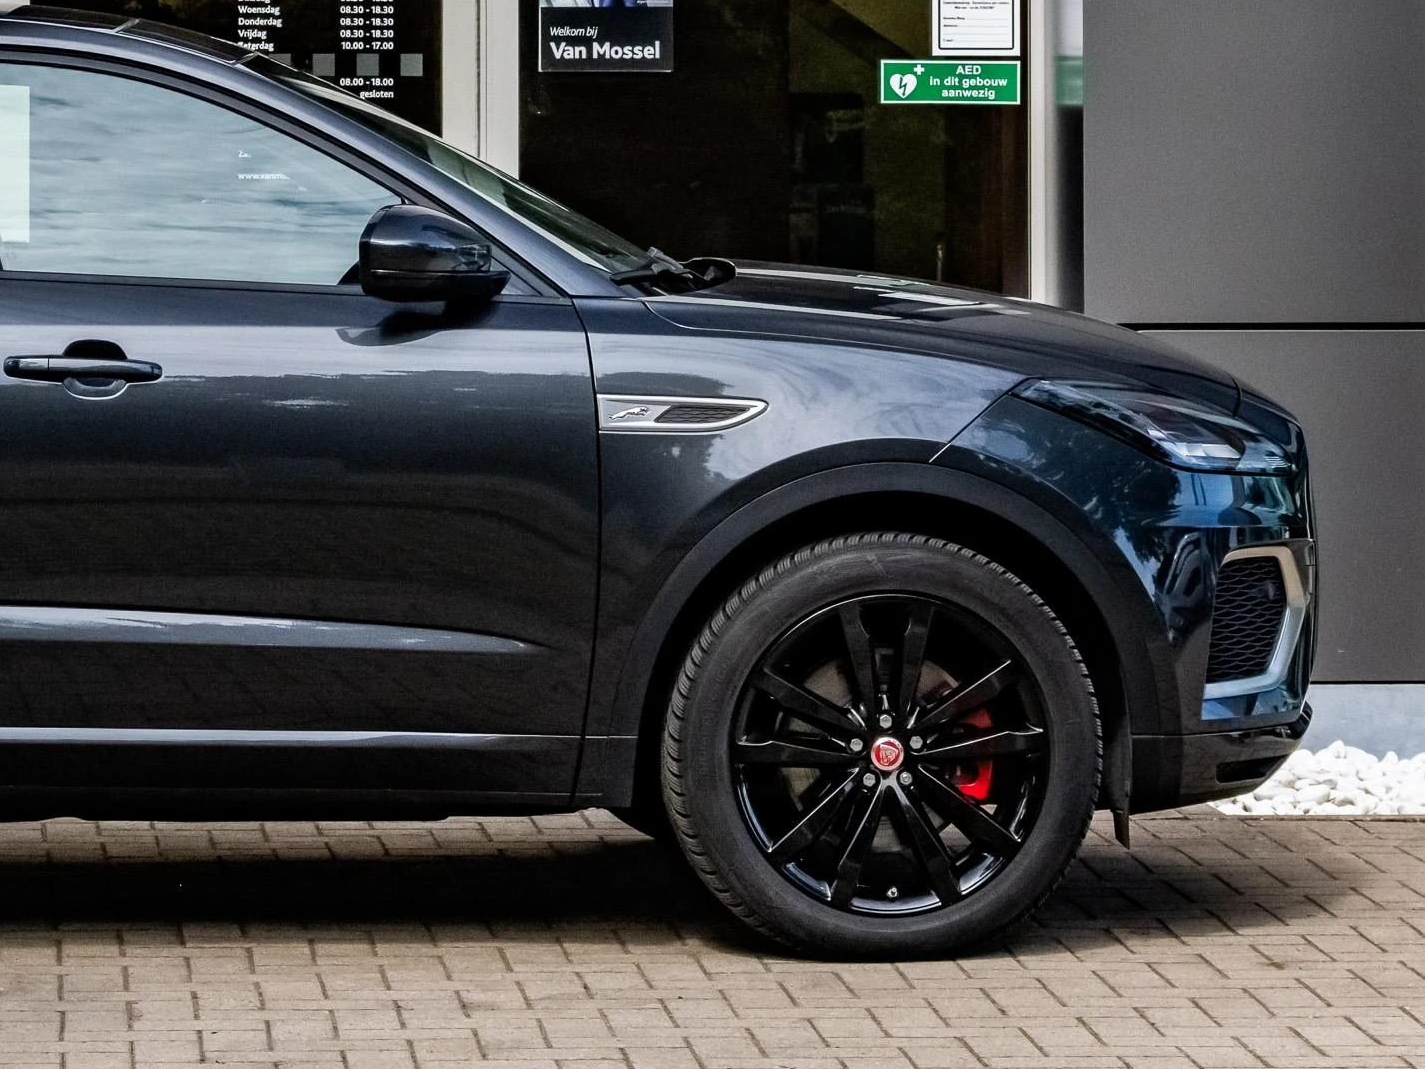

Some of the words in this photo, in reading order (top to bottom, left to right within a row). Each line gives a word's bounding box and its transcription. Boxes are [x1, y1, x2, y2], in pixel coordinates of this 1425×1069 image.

[237, 5, 281, 16] Woensdag
[339, 5, 364, 15] 08.30
[370, 5, 394, 15] 18.30
[237, 17, 283, 28] Donderdag
[339, 17, 364, 27] 08.30
[370, 17, 394, 27] 18.30
[237, 28, 267, 40] Vrijdag
[339, 29, 365, 38] 08.30
[370, 29, 394, 38] 18.30
[549, 25, 585, 37] Welkom
[586, 26, 599, 39] bij
[340, 41, 365, 50] 10.00
[371, 41, 394, 50] 17.00
[549, 41, 587, 60] Van
[592, 40, 661, 60] Mossel
[955, 64, 982, 75] AED
[339, 77, 364, 87] 08.00
[370, 77, 394, 87] 18.00
[929, 76, 942, 87] in
[943, 76, 960, 87] dit
[961, 76, 1008, 88] gebouw
[359, 89, 394, 100] gesloten
[941, 87, 996, 100] aanwezig
